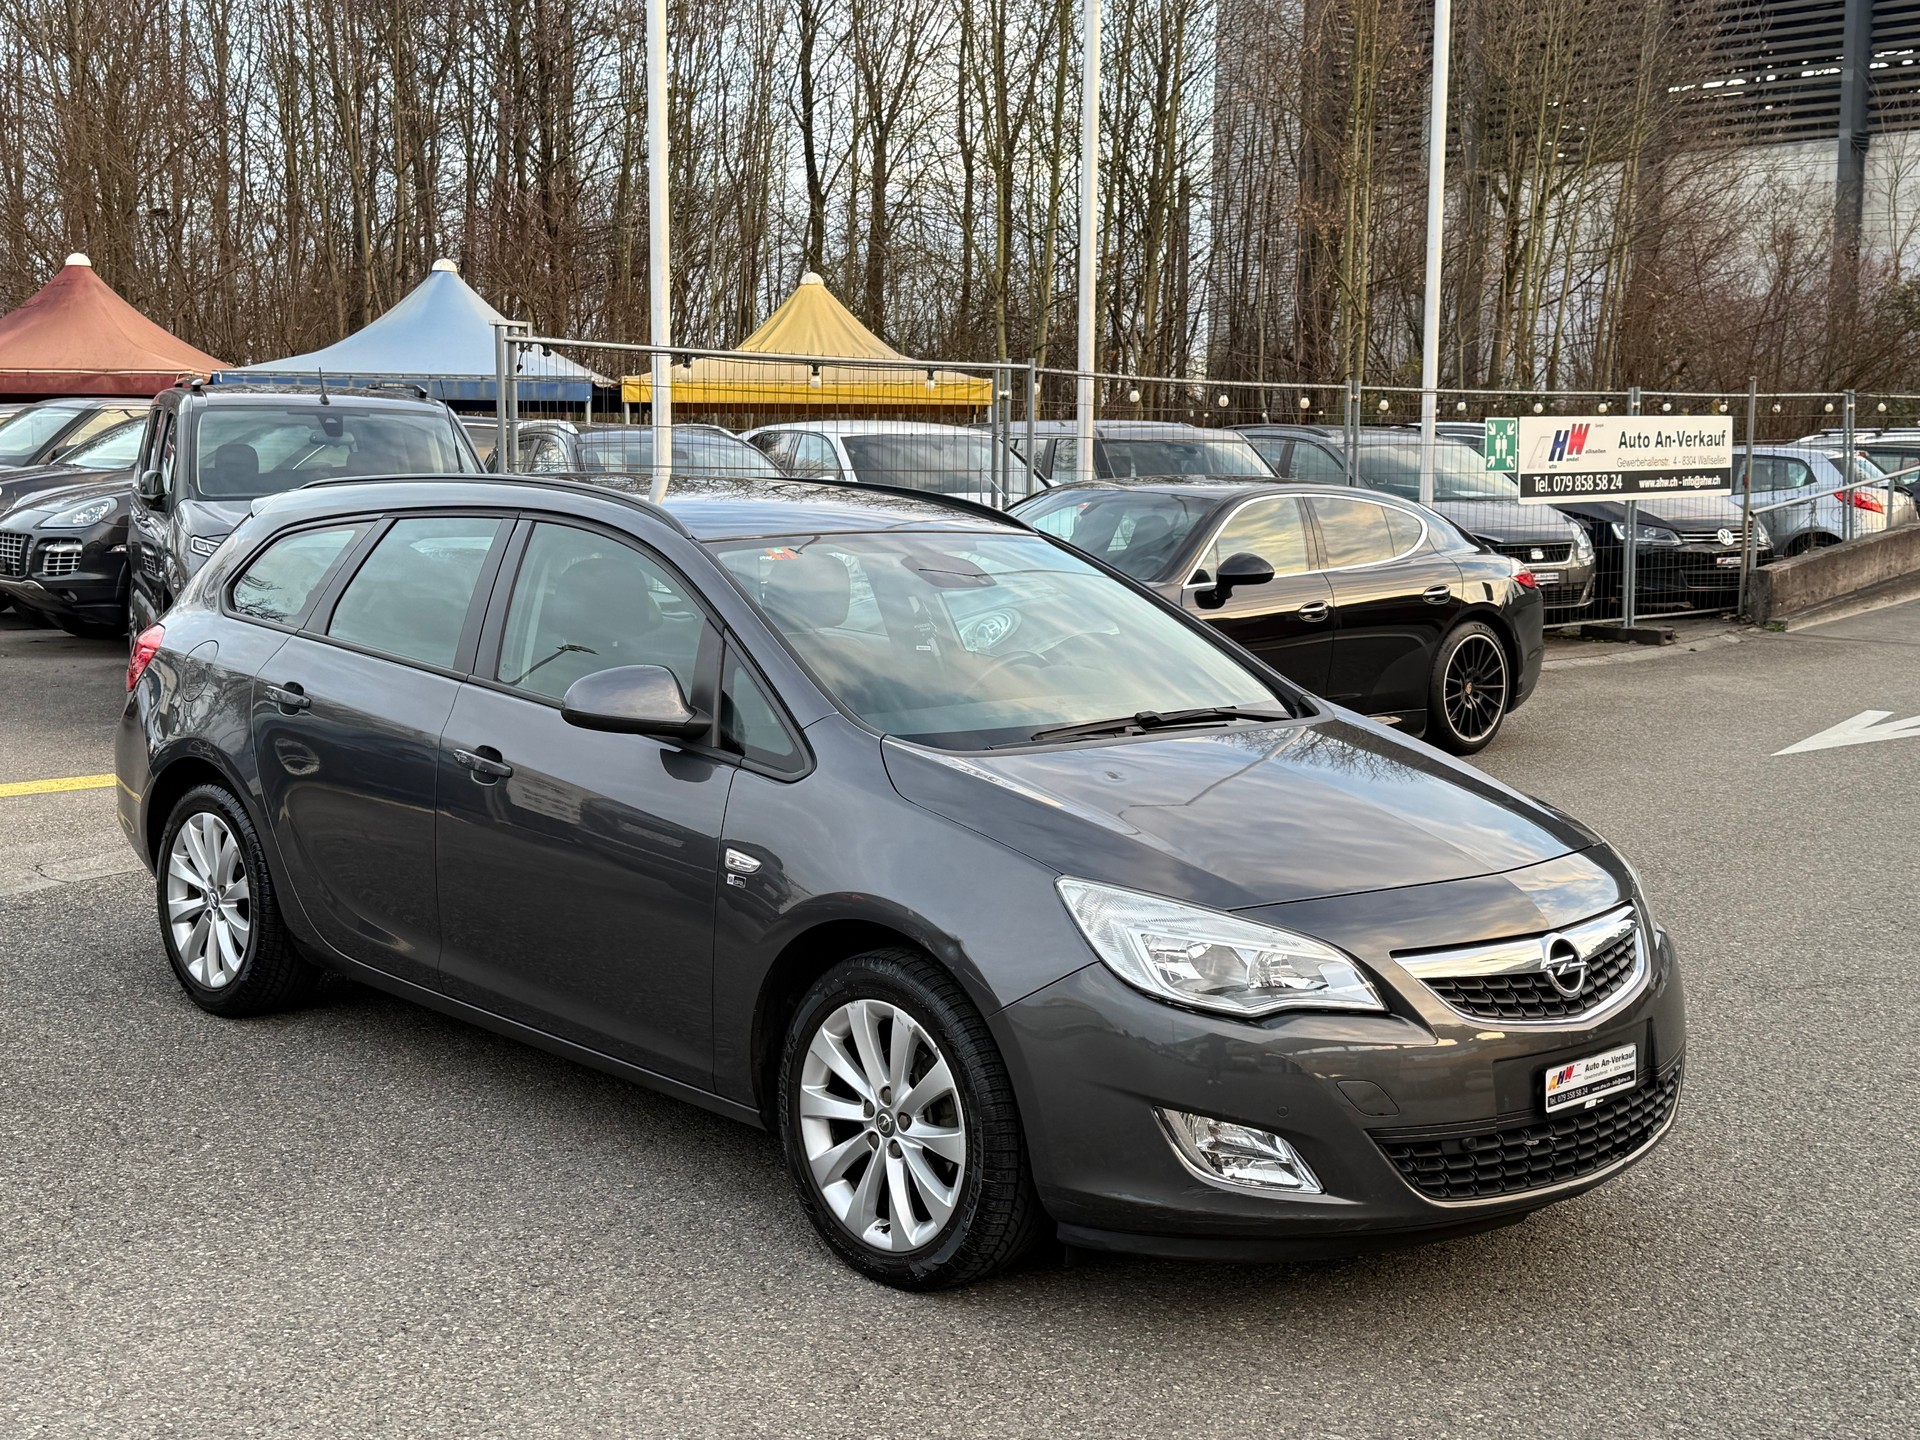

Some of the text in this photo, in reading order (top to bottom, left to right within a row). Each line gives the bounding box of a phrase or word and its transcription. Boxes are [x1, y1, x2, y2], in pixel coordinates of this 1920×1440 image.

[1618, 429, 1726, 448] Auto An-Verkauf
[1673, 456, 1677, 465] 4
[1682, 456, 1696, 466] 8304
[1698, 455, 1726, 465] Wallisellen
[1533, 474, 1623, 492] Tel. 079 858 58 24
[1638, 477, 1678, 488] www.ahw.ch
[1682, 475, 1721, 488] info@ahw.ch
[1584, 1063, 1599, 1073] Auto
[1601, 1049, 1635, 1067] An-Verkauf
[1548, 1064, 1575, 1091] AHW
